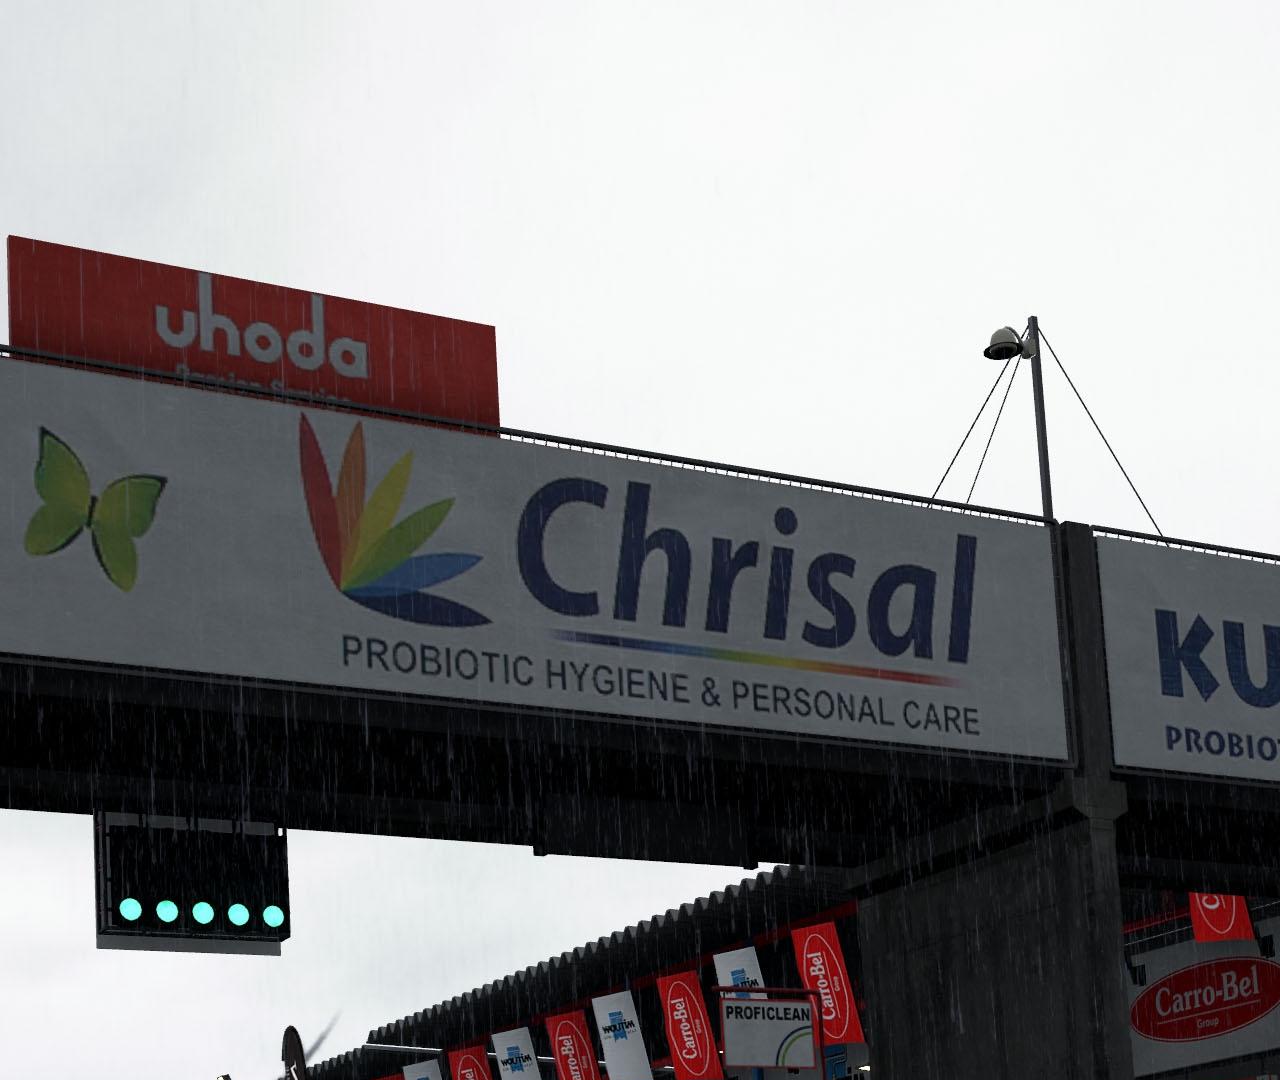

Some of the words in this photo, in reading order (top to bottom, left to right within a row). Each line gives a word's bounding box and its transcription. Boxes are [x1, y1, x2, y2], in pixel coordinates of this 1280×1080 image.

[155, 272, 370, 380] uhoda
[517, 477, 978, 664] Chrisal
[342, 634, 533, 687] PROBIOTIC
[546, 659, 691, 704] HYGIENE
[702, 677, 721, 707] &
[733, 680, 895, 727] PERSONAL
[903, 702, 981, 737] CARE
[725, 1004, 811, 1022] PROFICLEAN
[807, 952, 837, 1021] Carro-Bel
[1155, 964, 1261, 1017] Carro-Bel
[671, 997, 698, 1060] Carro-Bel
[1196, 1015, 1220, 1029] Group
